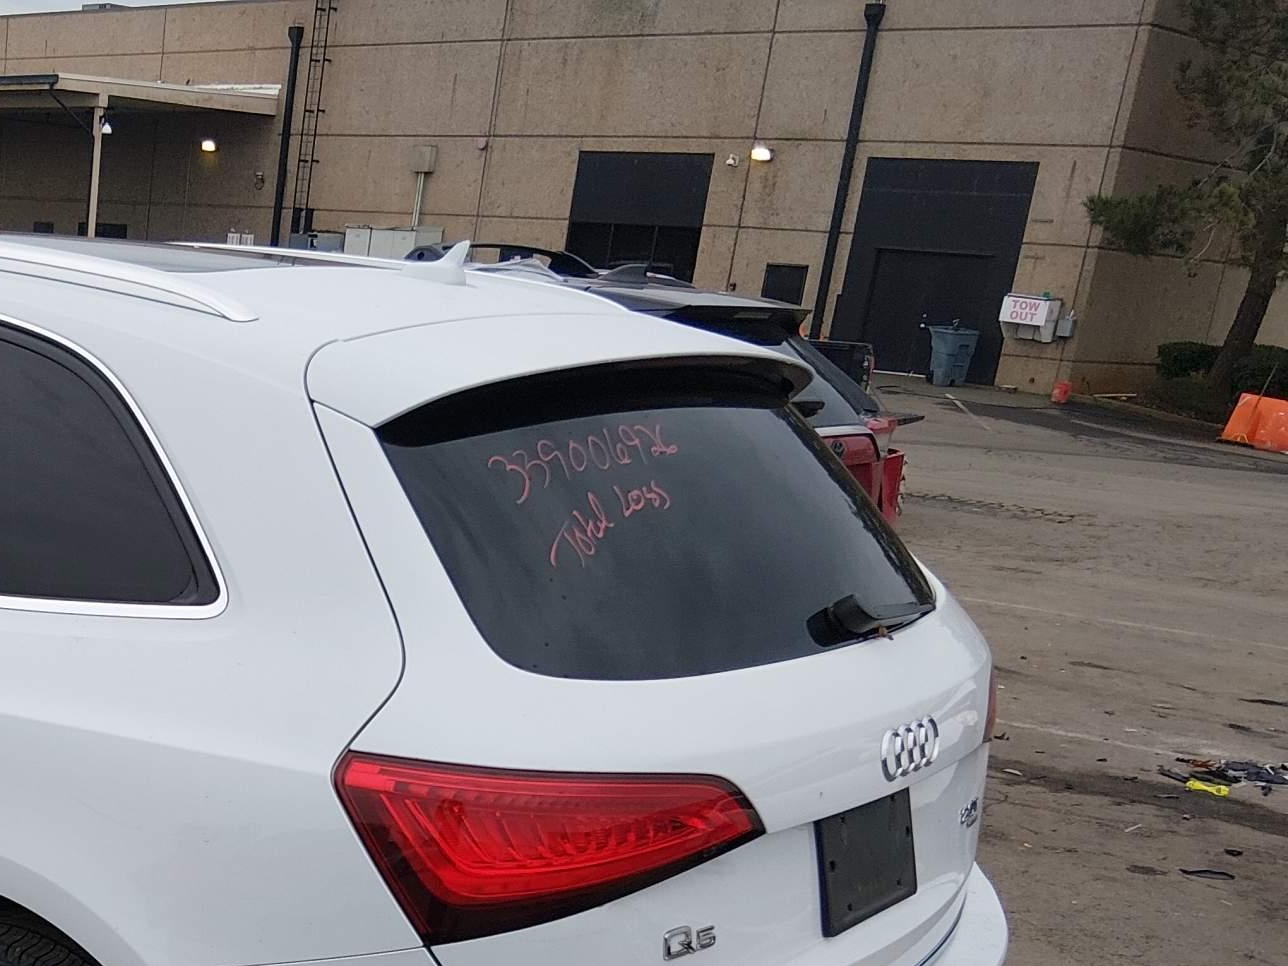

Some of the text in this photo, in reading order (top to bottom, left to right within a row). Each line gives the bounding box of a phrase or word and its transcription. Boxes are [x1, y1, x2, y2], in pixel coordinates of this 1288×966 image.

[1011, 299, 1041, 312] TOW
[1009, 310, 1038, 322] OUT
[662, 924, 717, 961] Q5
